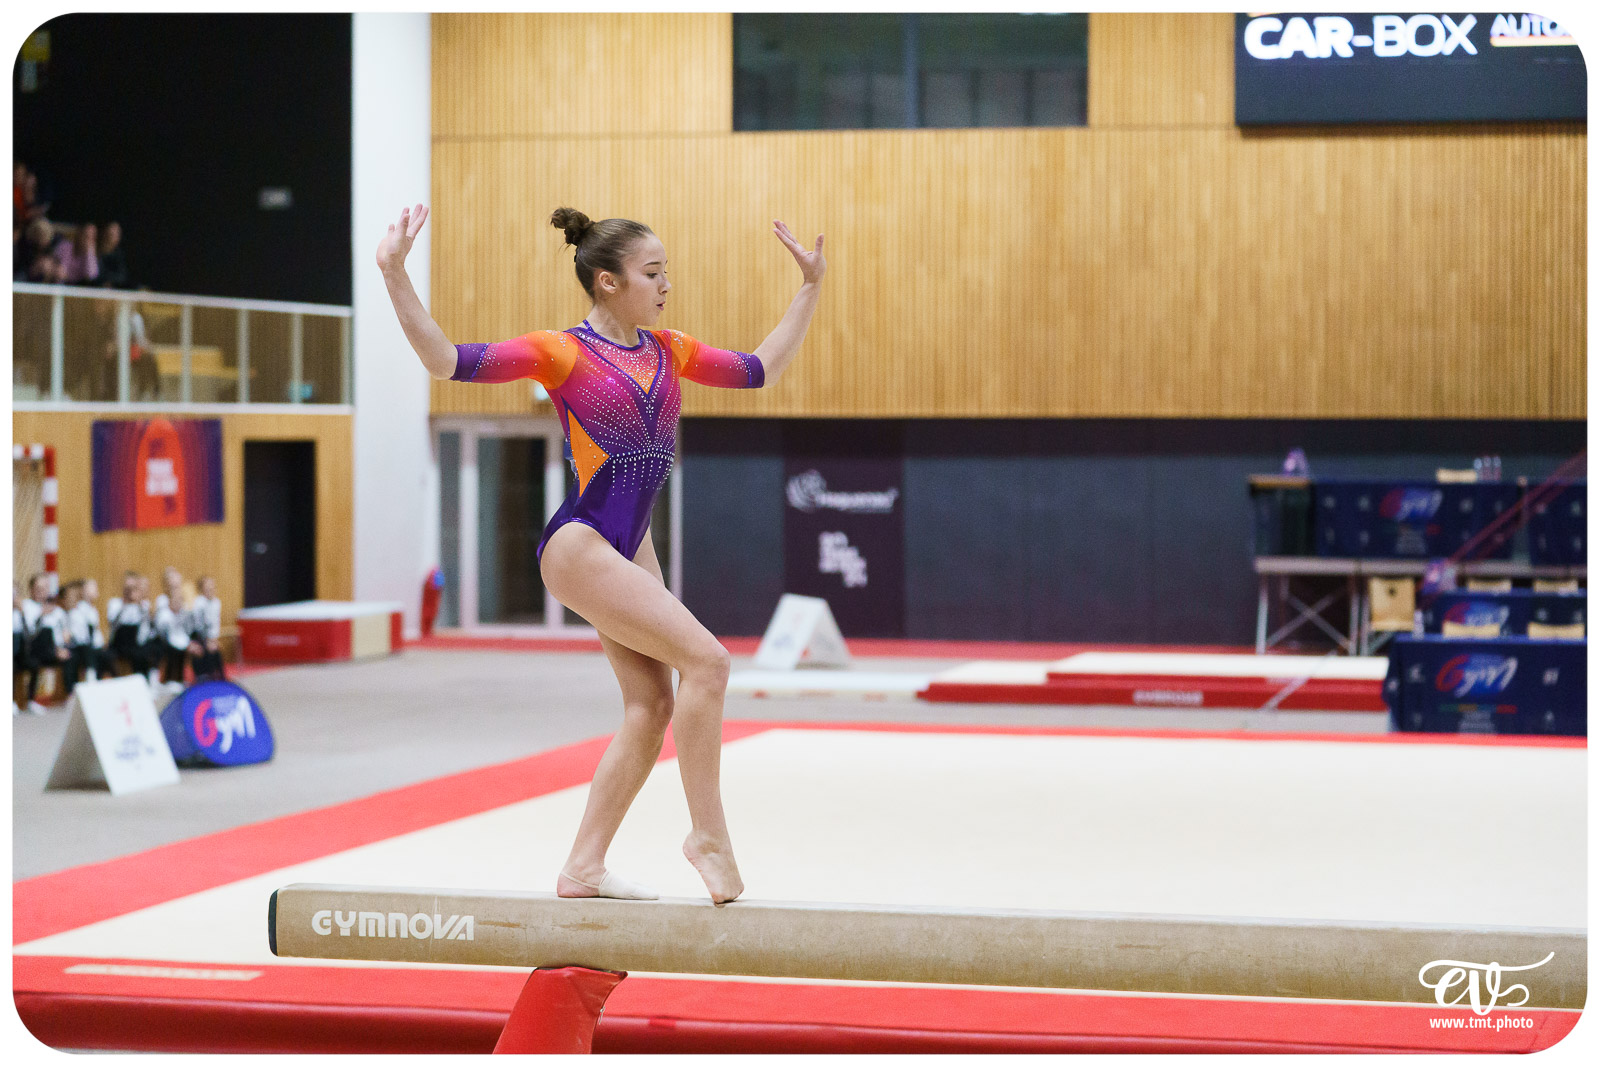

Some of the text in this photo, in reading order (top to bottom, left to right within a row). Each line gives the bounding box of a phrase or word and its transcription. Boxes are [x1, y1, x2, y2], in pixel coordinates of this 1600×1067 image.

[1244, 13, 1571, 60] CAR-BOX AUTO
[311, 909, 475, 941] GYMNOVA
